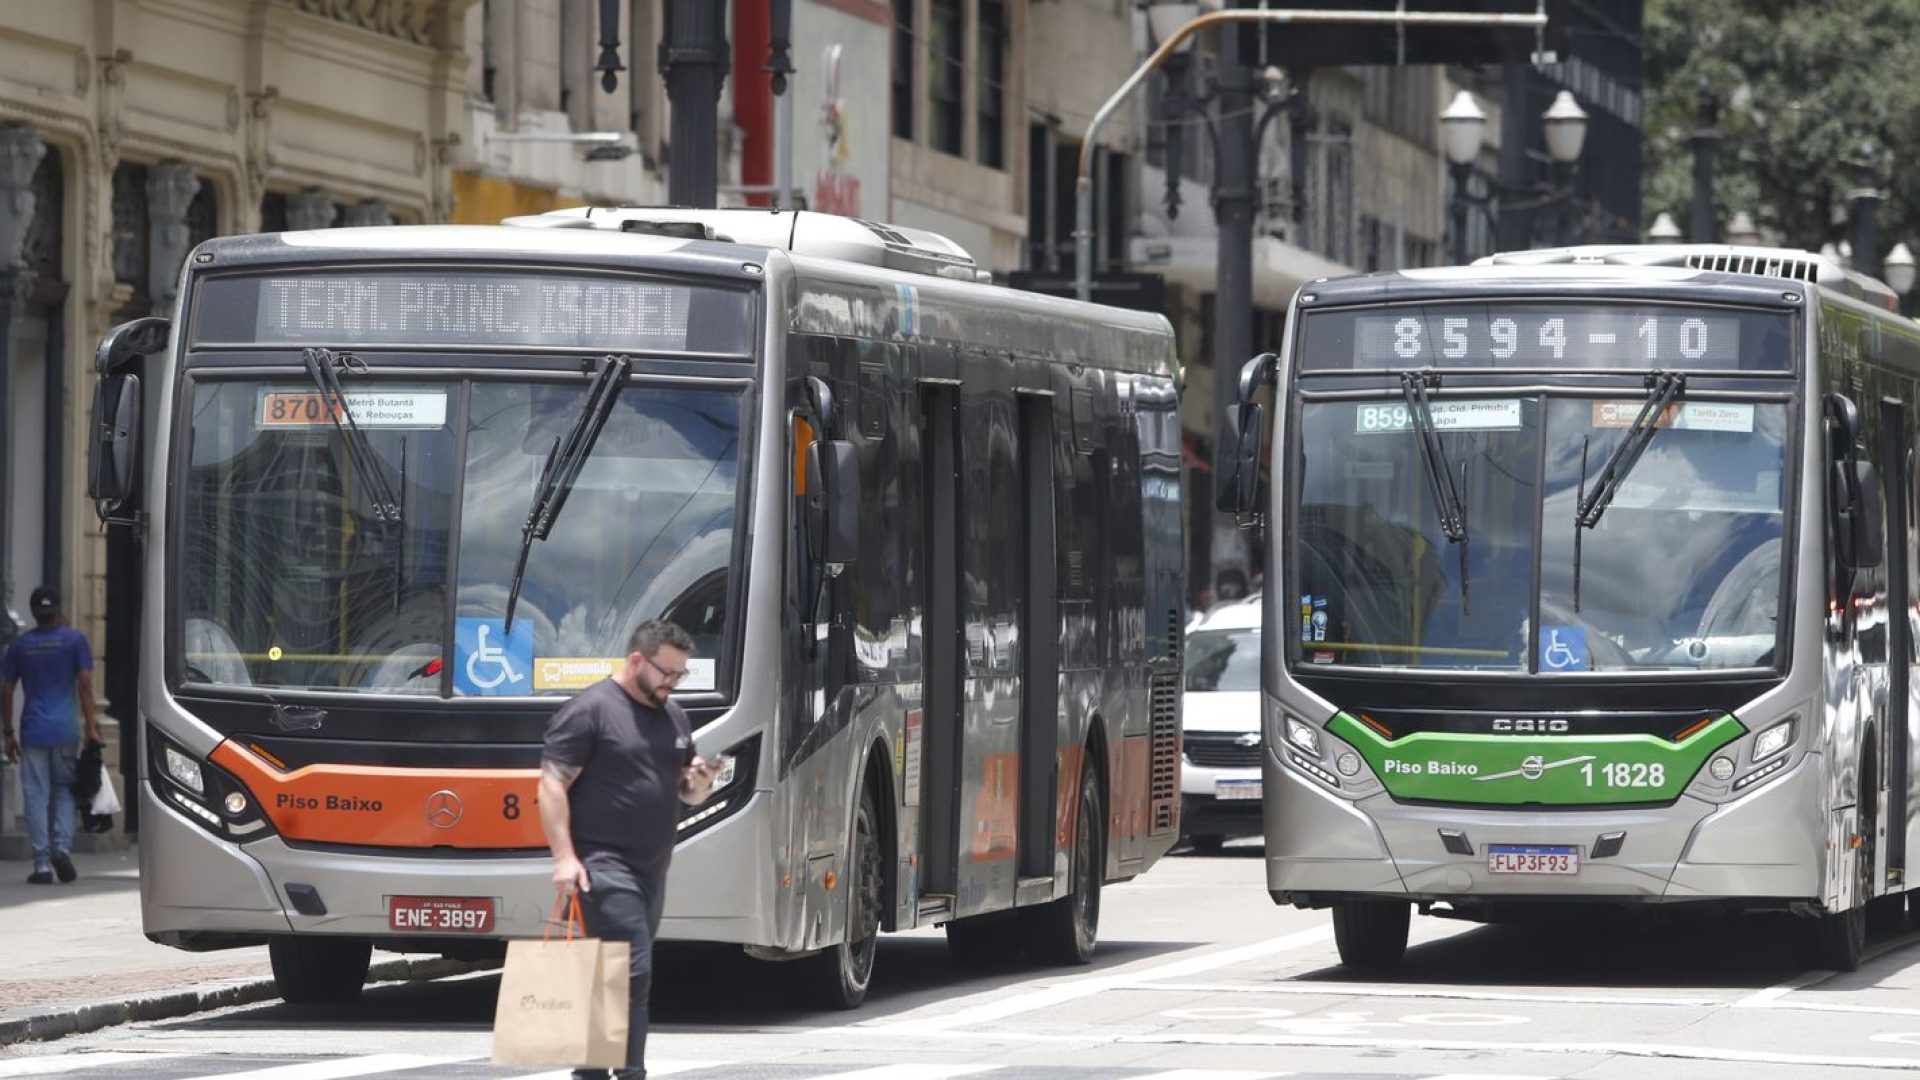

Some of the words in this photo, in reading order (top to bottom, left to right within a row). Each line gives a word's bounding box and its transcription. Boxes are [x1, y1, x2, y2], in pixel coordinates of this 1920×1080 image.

[271, 280, 387, 330] TERM.
[400, 282, 529, 333] PRINC.
[542, 285, 687, 336] ISABEL
[1394, 318, 1708, 358] 8594-10
[377, 399, 414, 407] Butantã
[1471, 403, 1509, 412] Pirituba
[366, 410, 414, 420] Rebouças
[1363, 407, 1426, 428] 859
[1493, 719, 1569, 732] CAIO
[1384, 760, 1422, 774] Piso
[1427, 762, 1478, 775] Baixo
[276, 794, 318, 809] Piso
[326, 796, 383, 812] Baixo
[1496, 855, 1569, 871] FLP3F93
